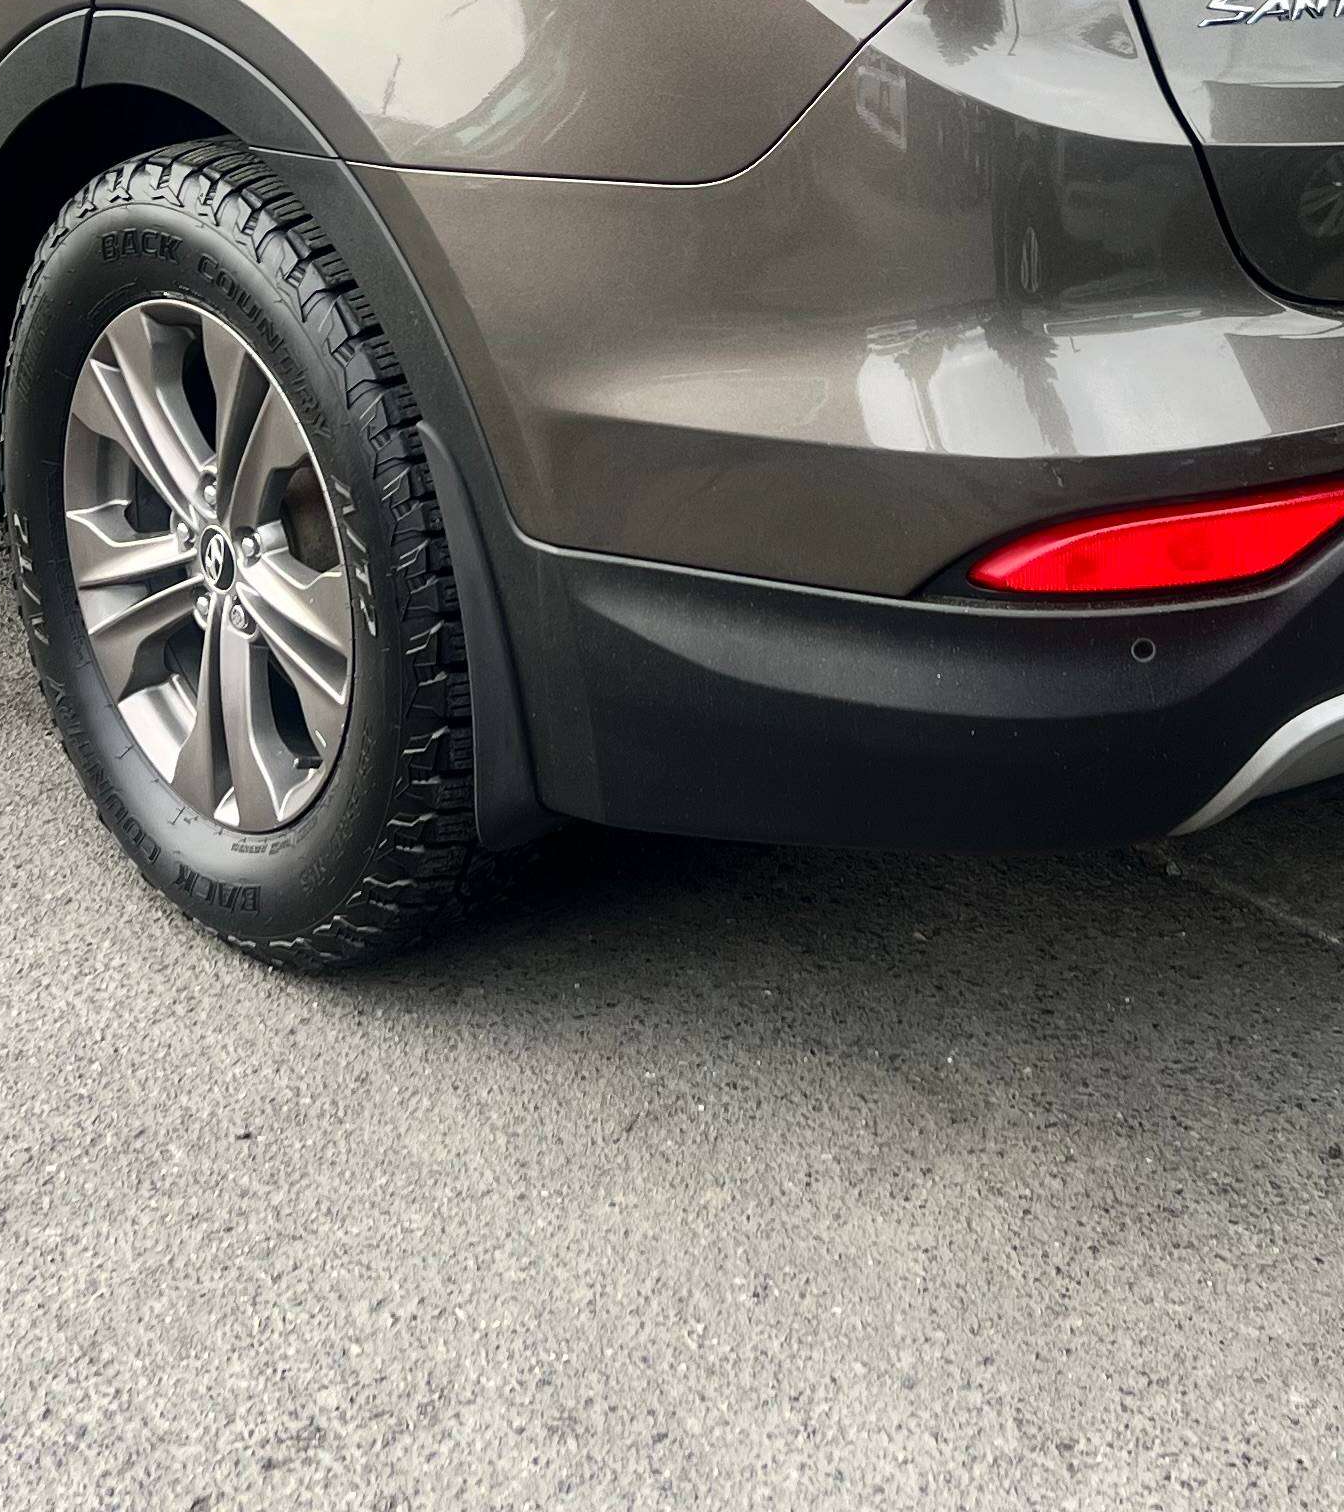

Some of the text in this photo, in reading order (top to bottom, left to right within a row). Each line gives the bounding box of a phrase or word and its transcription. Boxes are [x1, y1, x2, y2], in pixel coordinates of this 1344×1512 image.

[101, 227, 184, 265] BACK
[197, 254, 333, 439] COUNTRY
[172, 862, 262, 915] BACK
